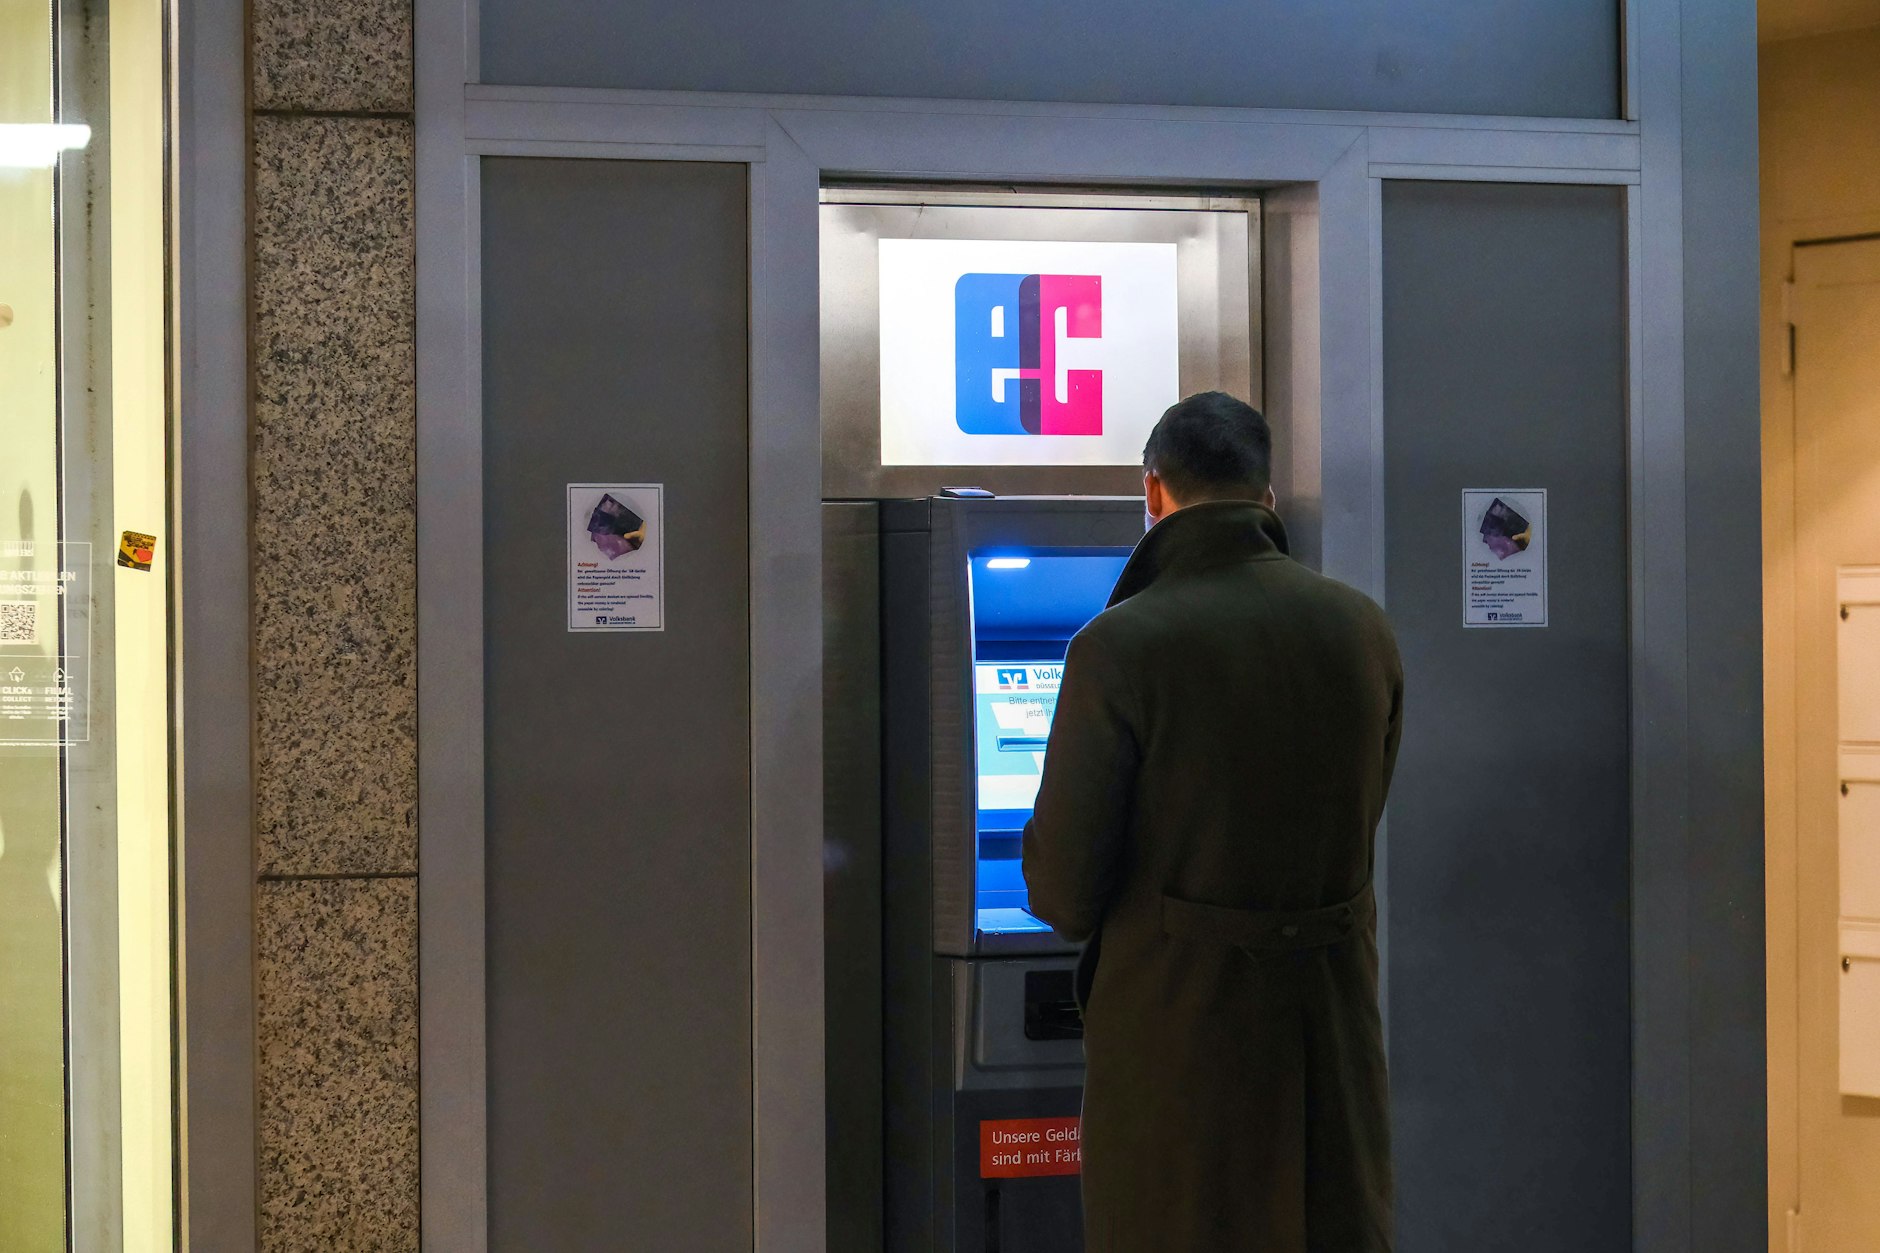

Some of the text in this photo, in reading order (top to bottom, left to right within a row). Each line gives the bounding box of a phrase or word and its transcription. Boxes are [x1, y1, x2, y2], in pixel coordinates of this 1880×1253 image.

[1009, 697, 1028, 705] Bitte
[1026, 709, 1044, 718] jetzt
[992, 1131, 1041, 1144] Unsere
[992, 1150, 1021, 1165] sind
[1027, 1150, 1050, 1164] mit
